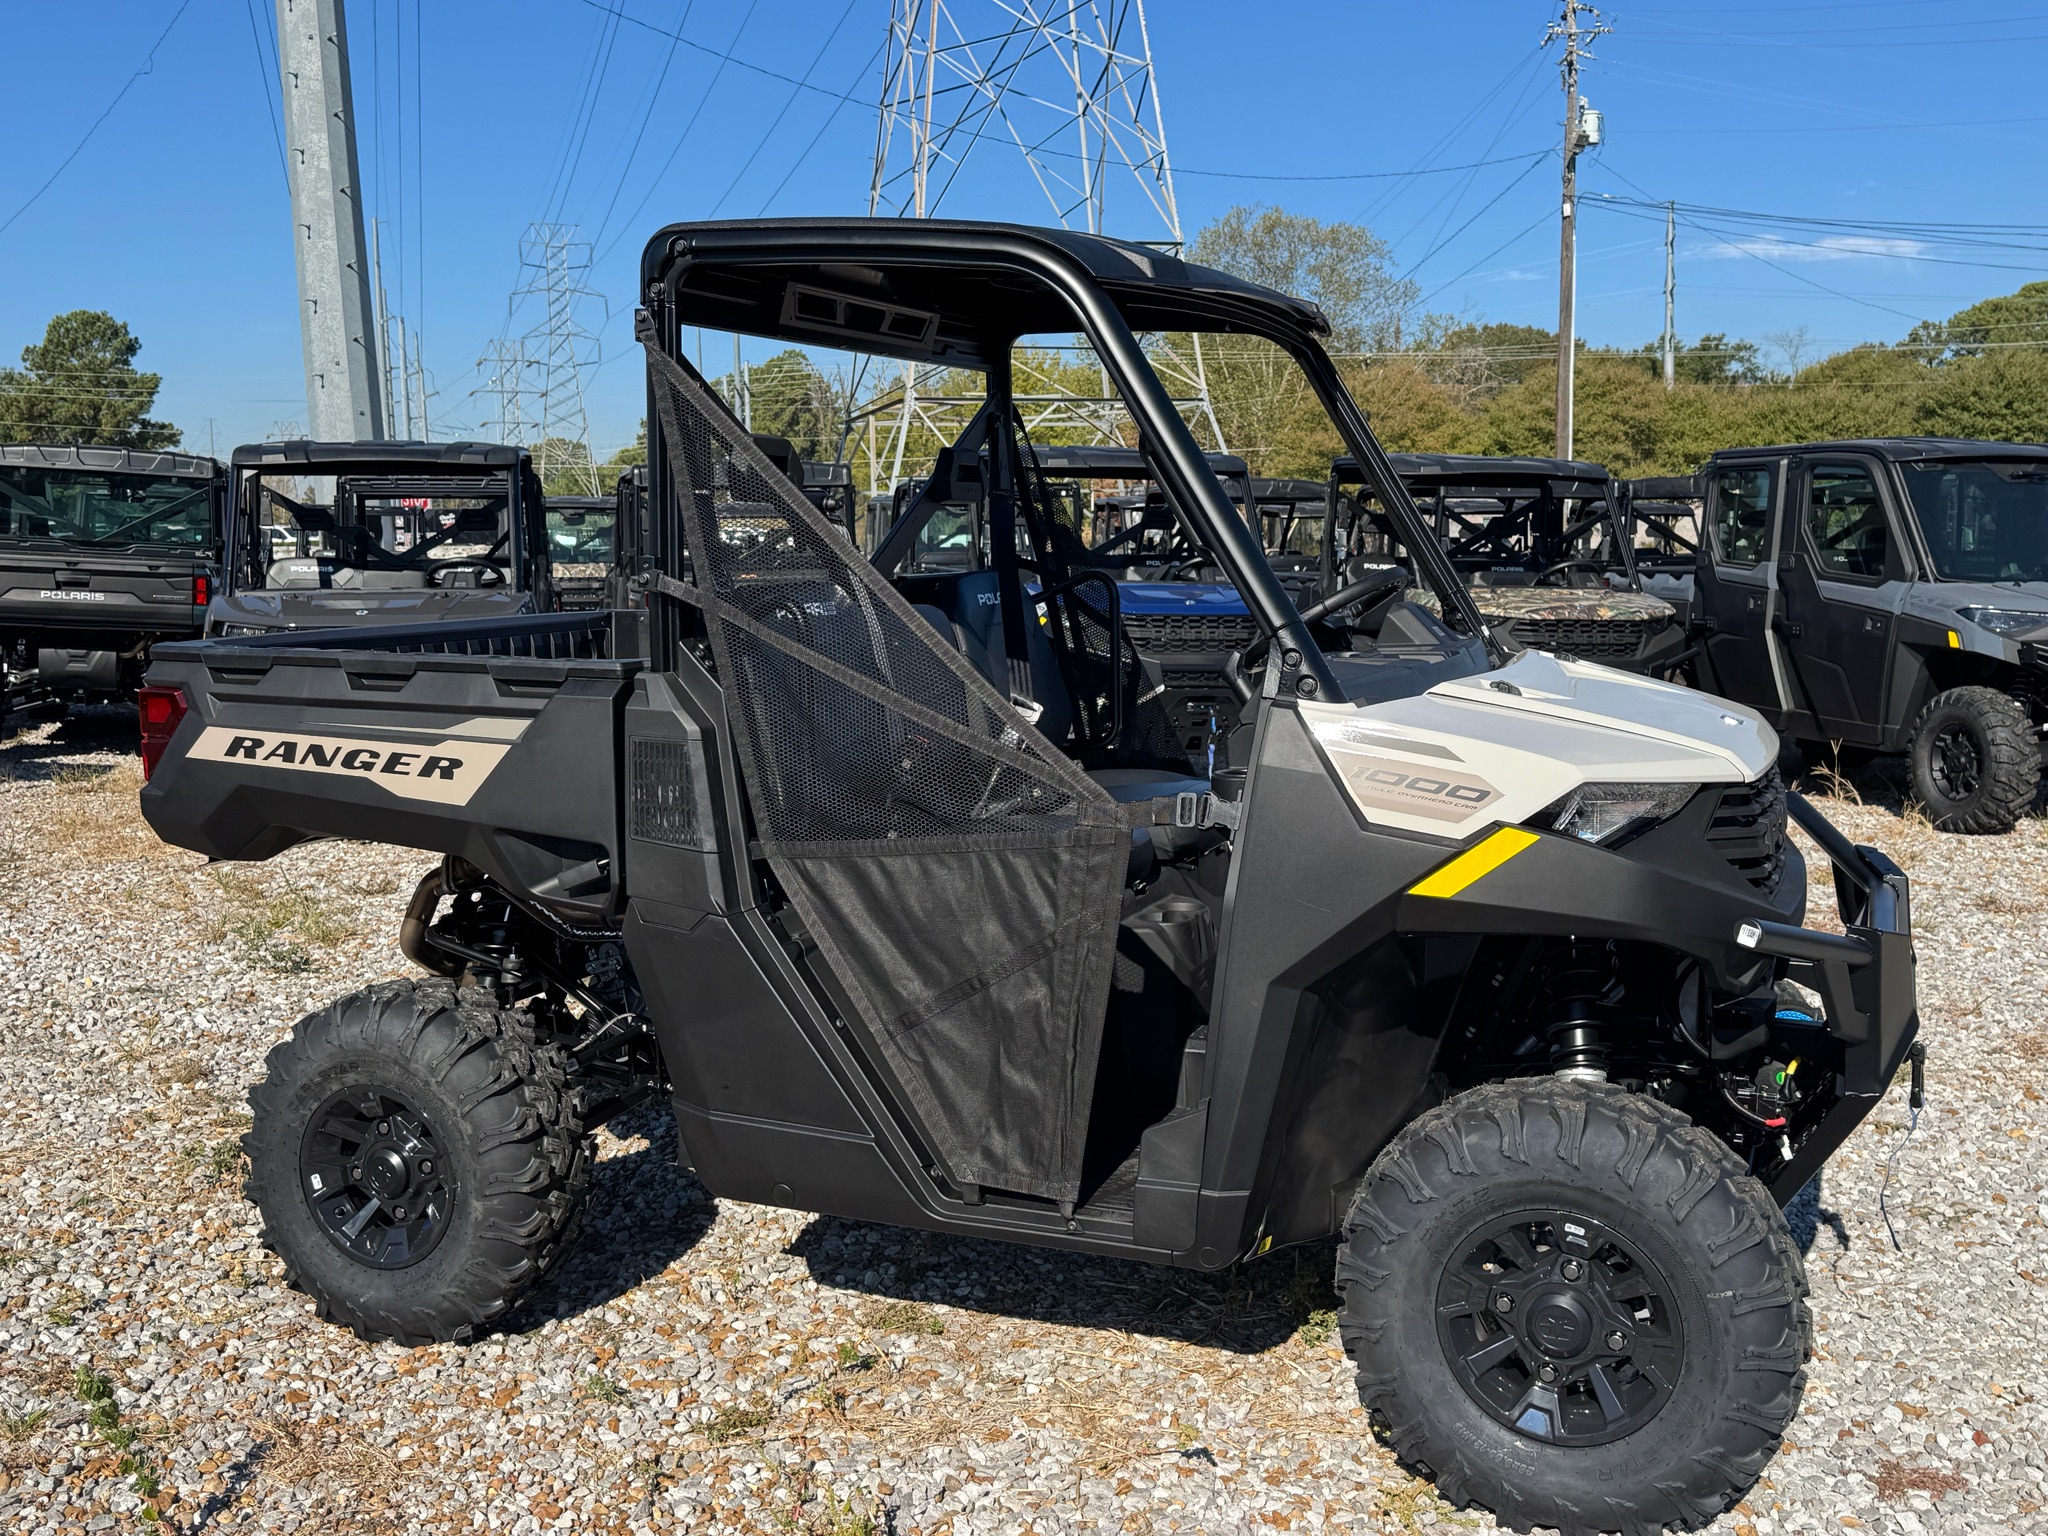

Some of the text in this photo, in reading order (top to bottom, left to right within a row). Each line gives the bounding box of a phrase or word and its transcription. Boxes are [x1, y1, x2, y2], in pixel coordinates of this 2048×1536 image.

[40, 590, 105, 601] POLARIS
[1152, 627, 1238, 640] POLARIS
[224, 736, 464, 780] RANGER
[1348, 765, 1492, 803] 1000
[1397, 791, 1453, 806] OVERHEAD
[1453, 802, 1478, 811] CAM
[286, 1061, 362, 1114] CARLSTAR
[1595, 1395, 1708, 1483] CARLSTAR
